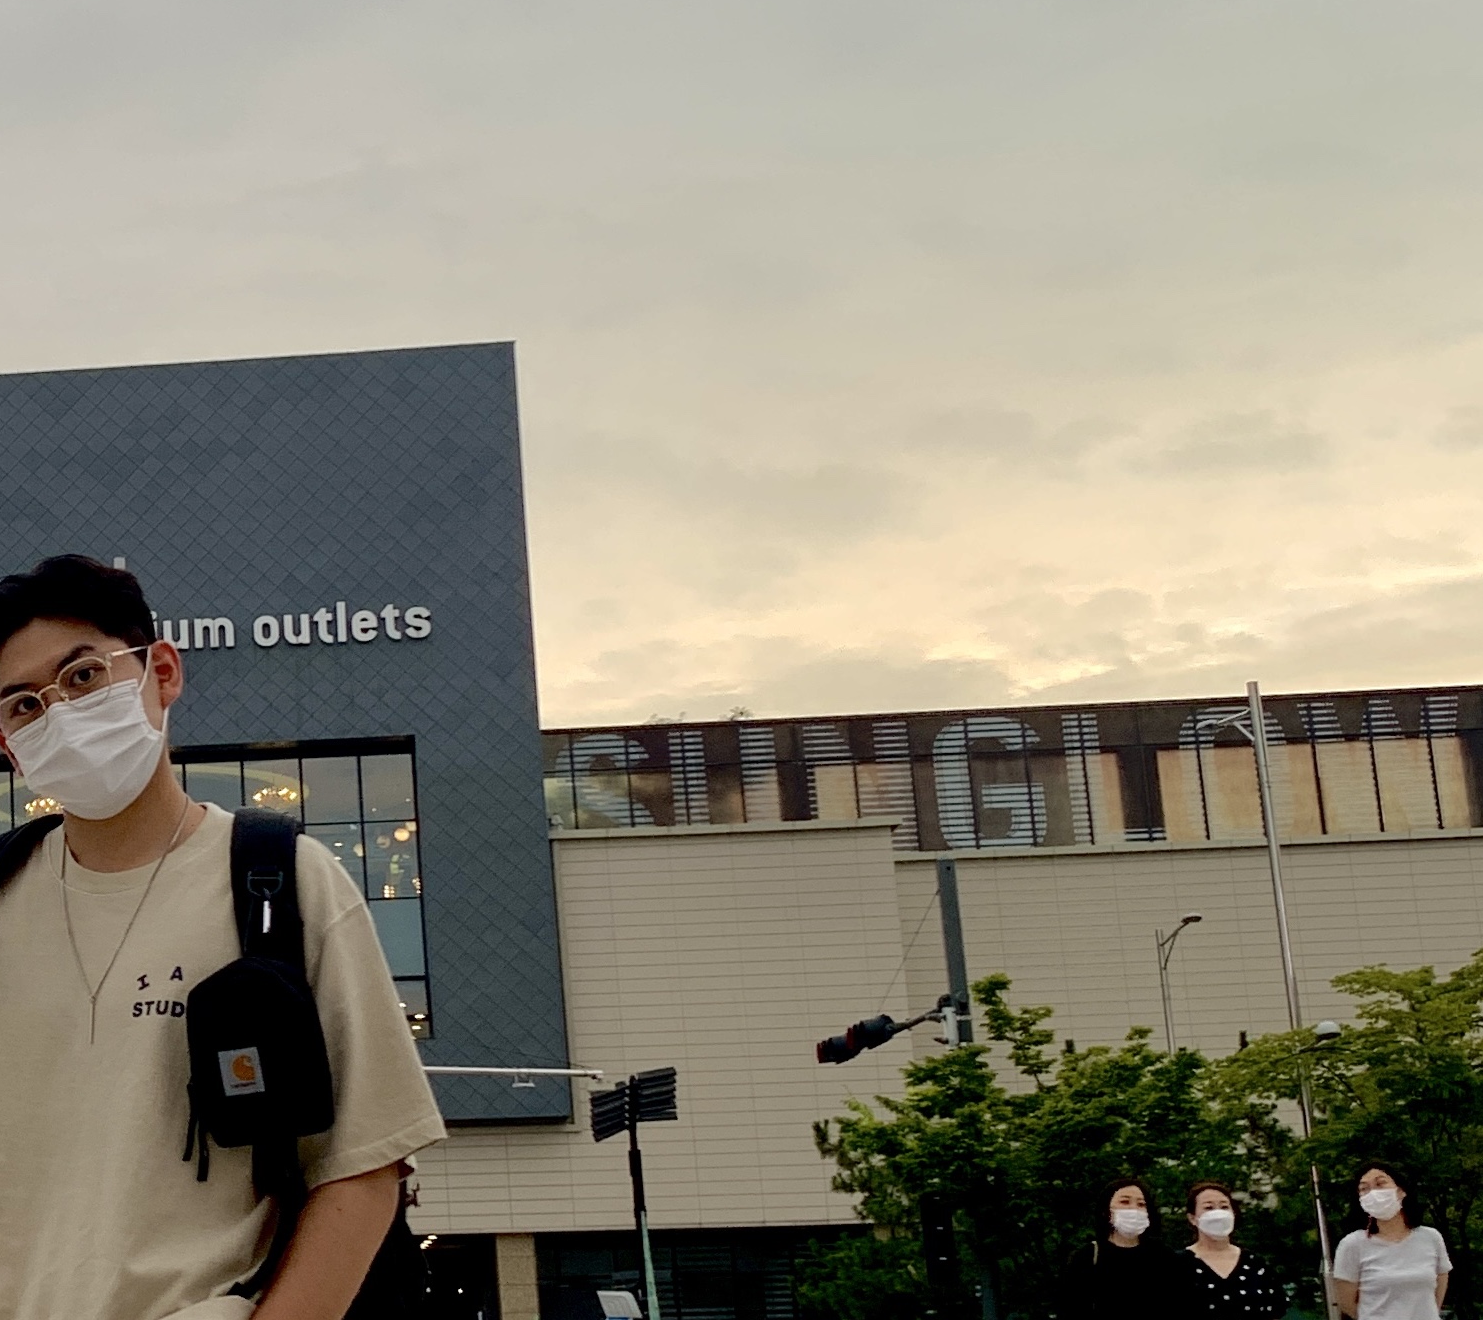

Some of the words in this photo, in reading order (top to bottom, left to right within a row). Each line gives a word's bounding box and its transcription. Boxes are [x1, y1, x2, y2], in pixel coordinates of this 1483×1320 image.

[253, 601, 433, 648] outlets
[136, 974, 149, 991] I
[132, 1000, 185, 1018] STUD
